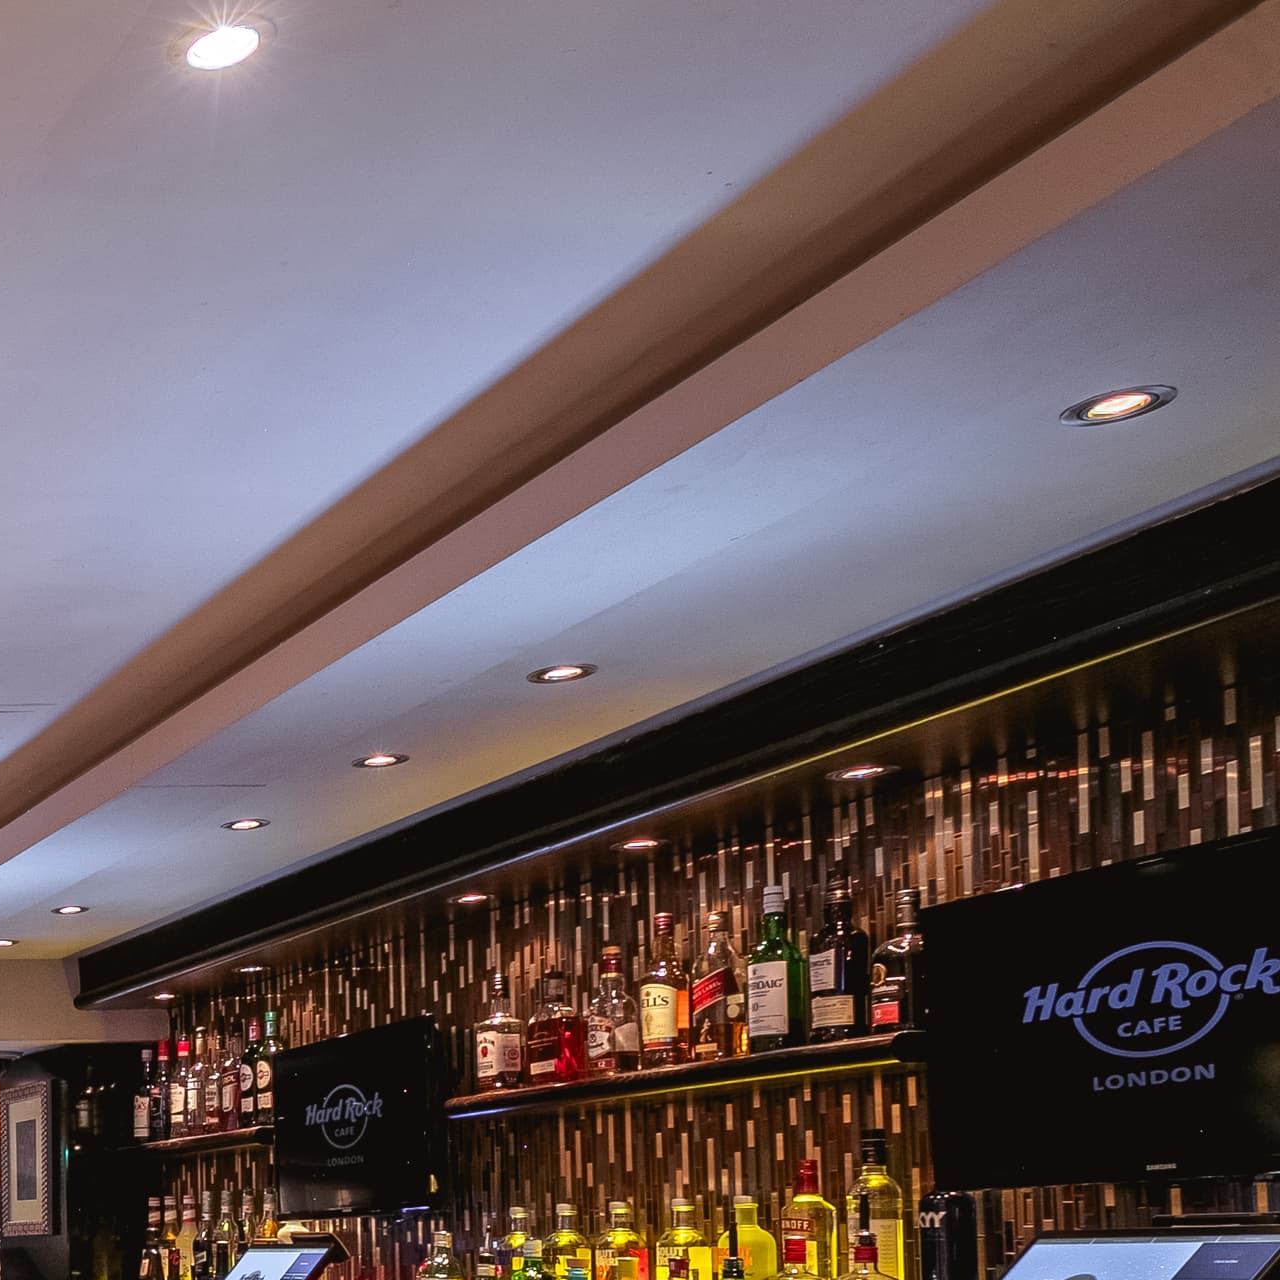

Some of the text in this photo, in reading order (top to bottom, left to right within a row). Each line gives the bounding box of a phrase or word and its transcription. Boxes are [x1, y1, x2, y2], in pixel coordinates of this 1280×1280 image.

[1022, 947, 1280, 1023] Hard Rock
[1117, 1015, 1182, 1038] CAFE
[1092, 1063, 1216, 1092] LONDON
[305, 1092, 383, 1126] Hard Rock
[334, 1126, 355, 1137] CAFE
[327, 1155, 365, 1167] LONDON
